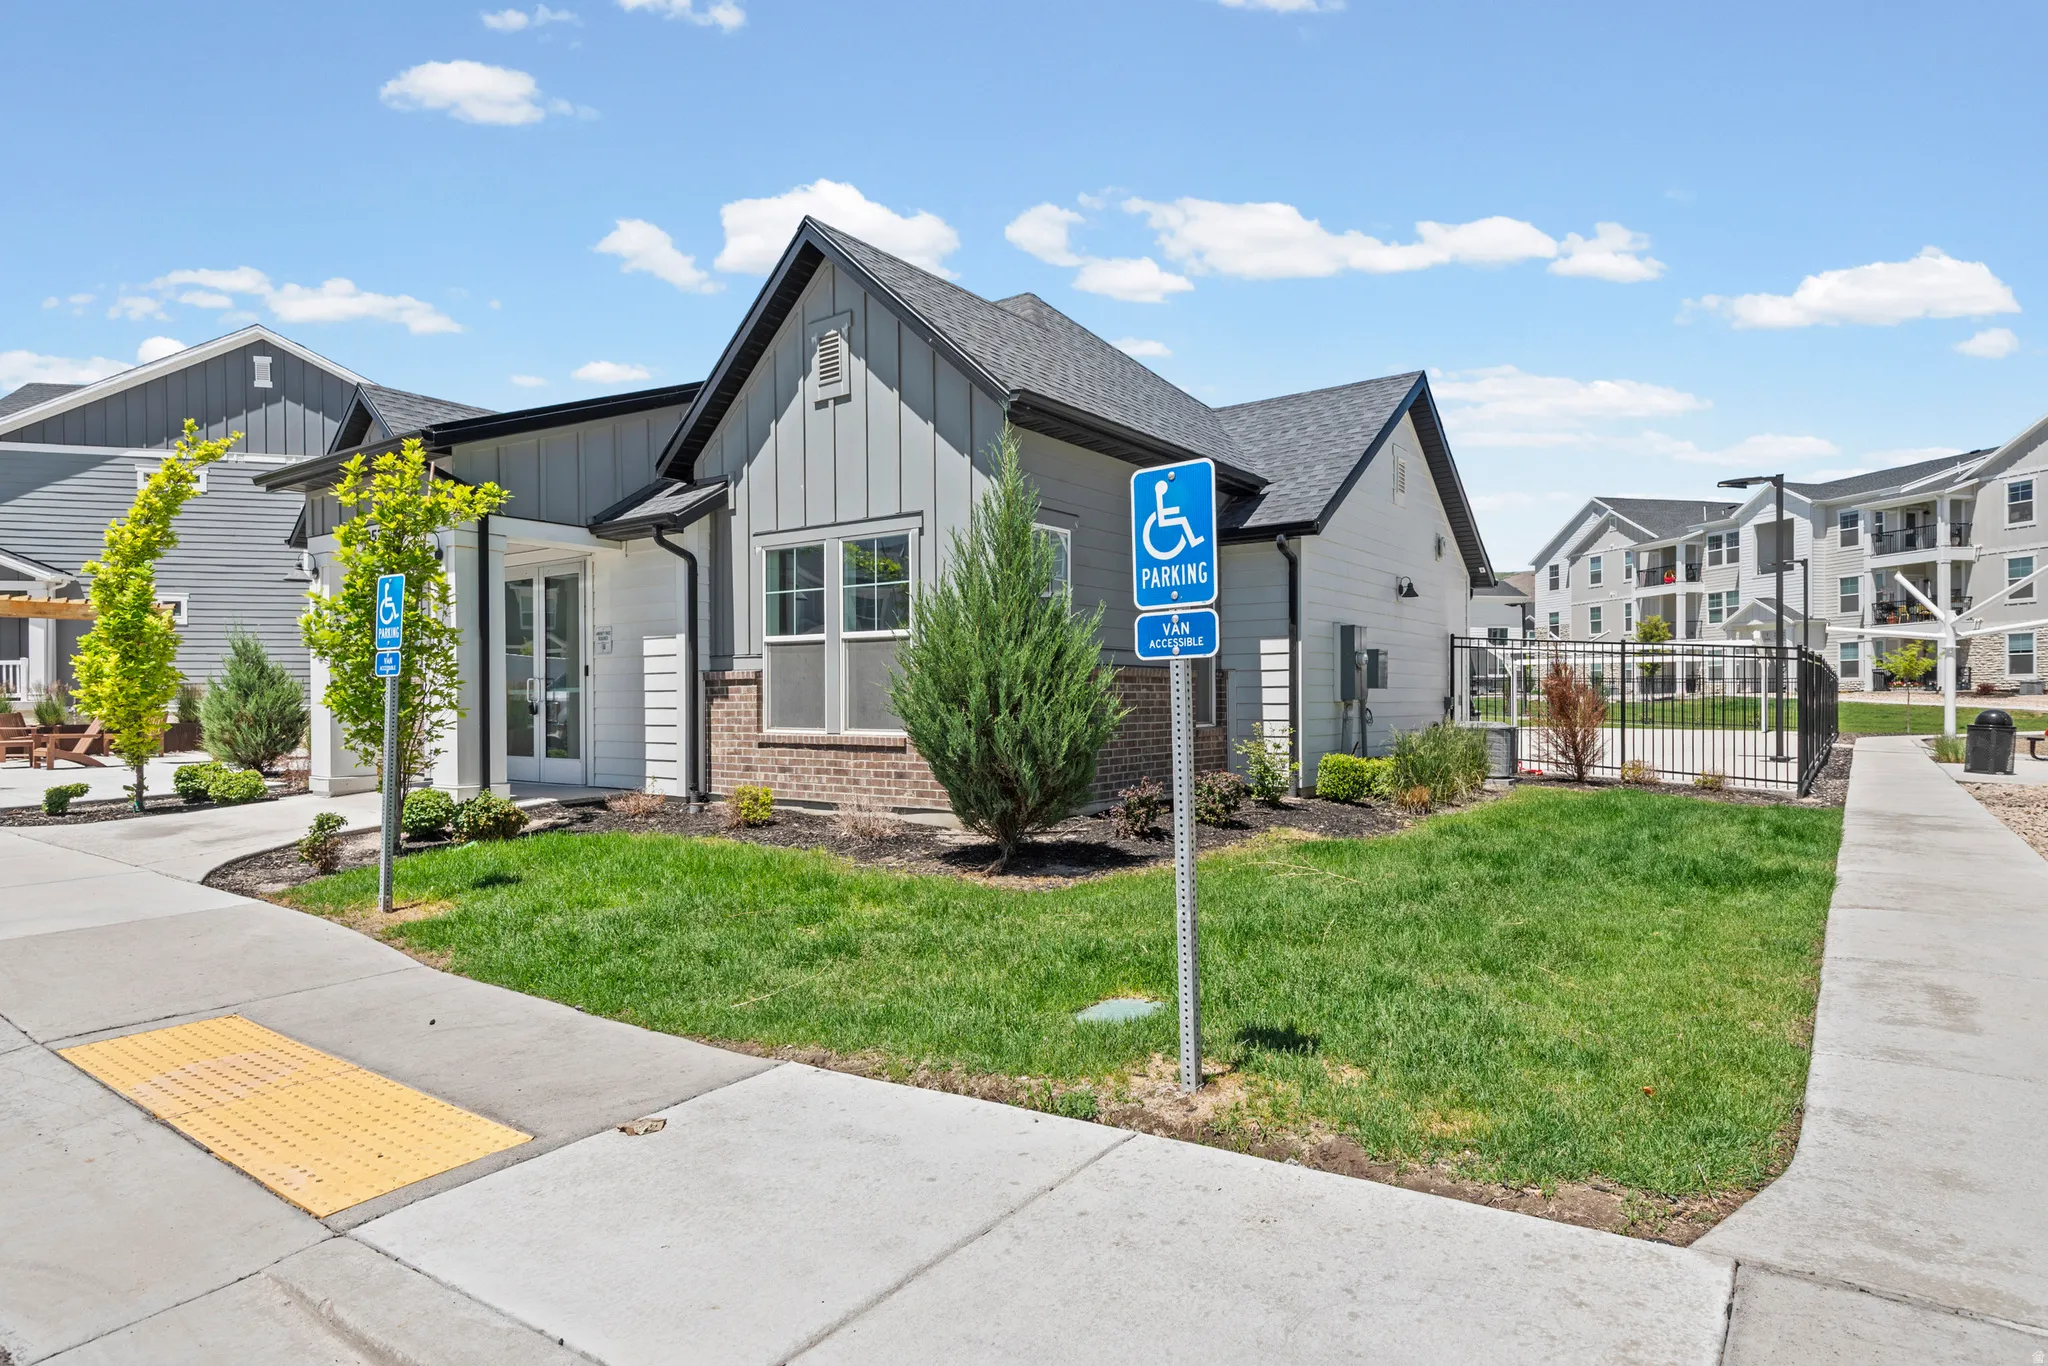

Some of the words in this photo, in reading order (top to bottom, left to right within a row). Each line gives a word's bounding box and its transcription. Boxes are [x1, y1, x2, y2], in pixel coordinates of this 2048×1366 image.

[1142, 561, 1208, 589] PARKING
[379, 627, 399, 639] PARKING
[1162, 622, 1190, 636] VAN
[1149, 637, 1204, 649] ACCESSIBLE
